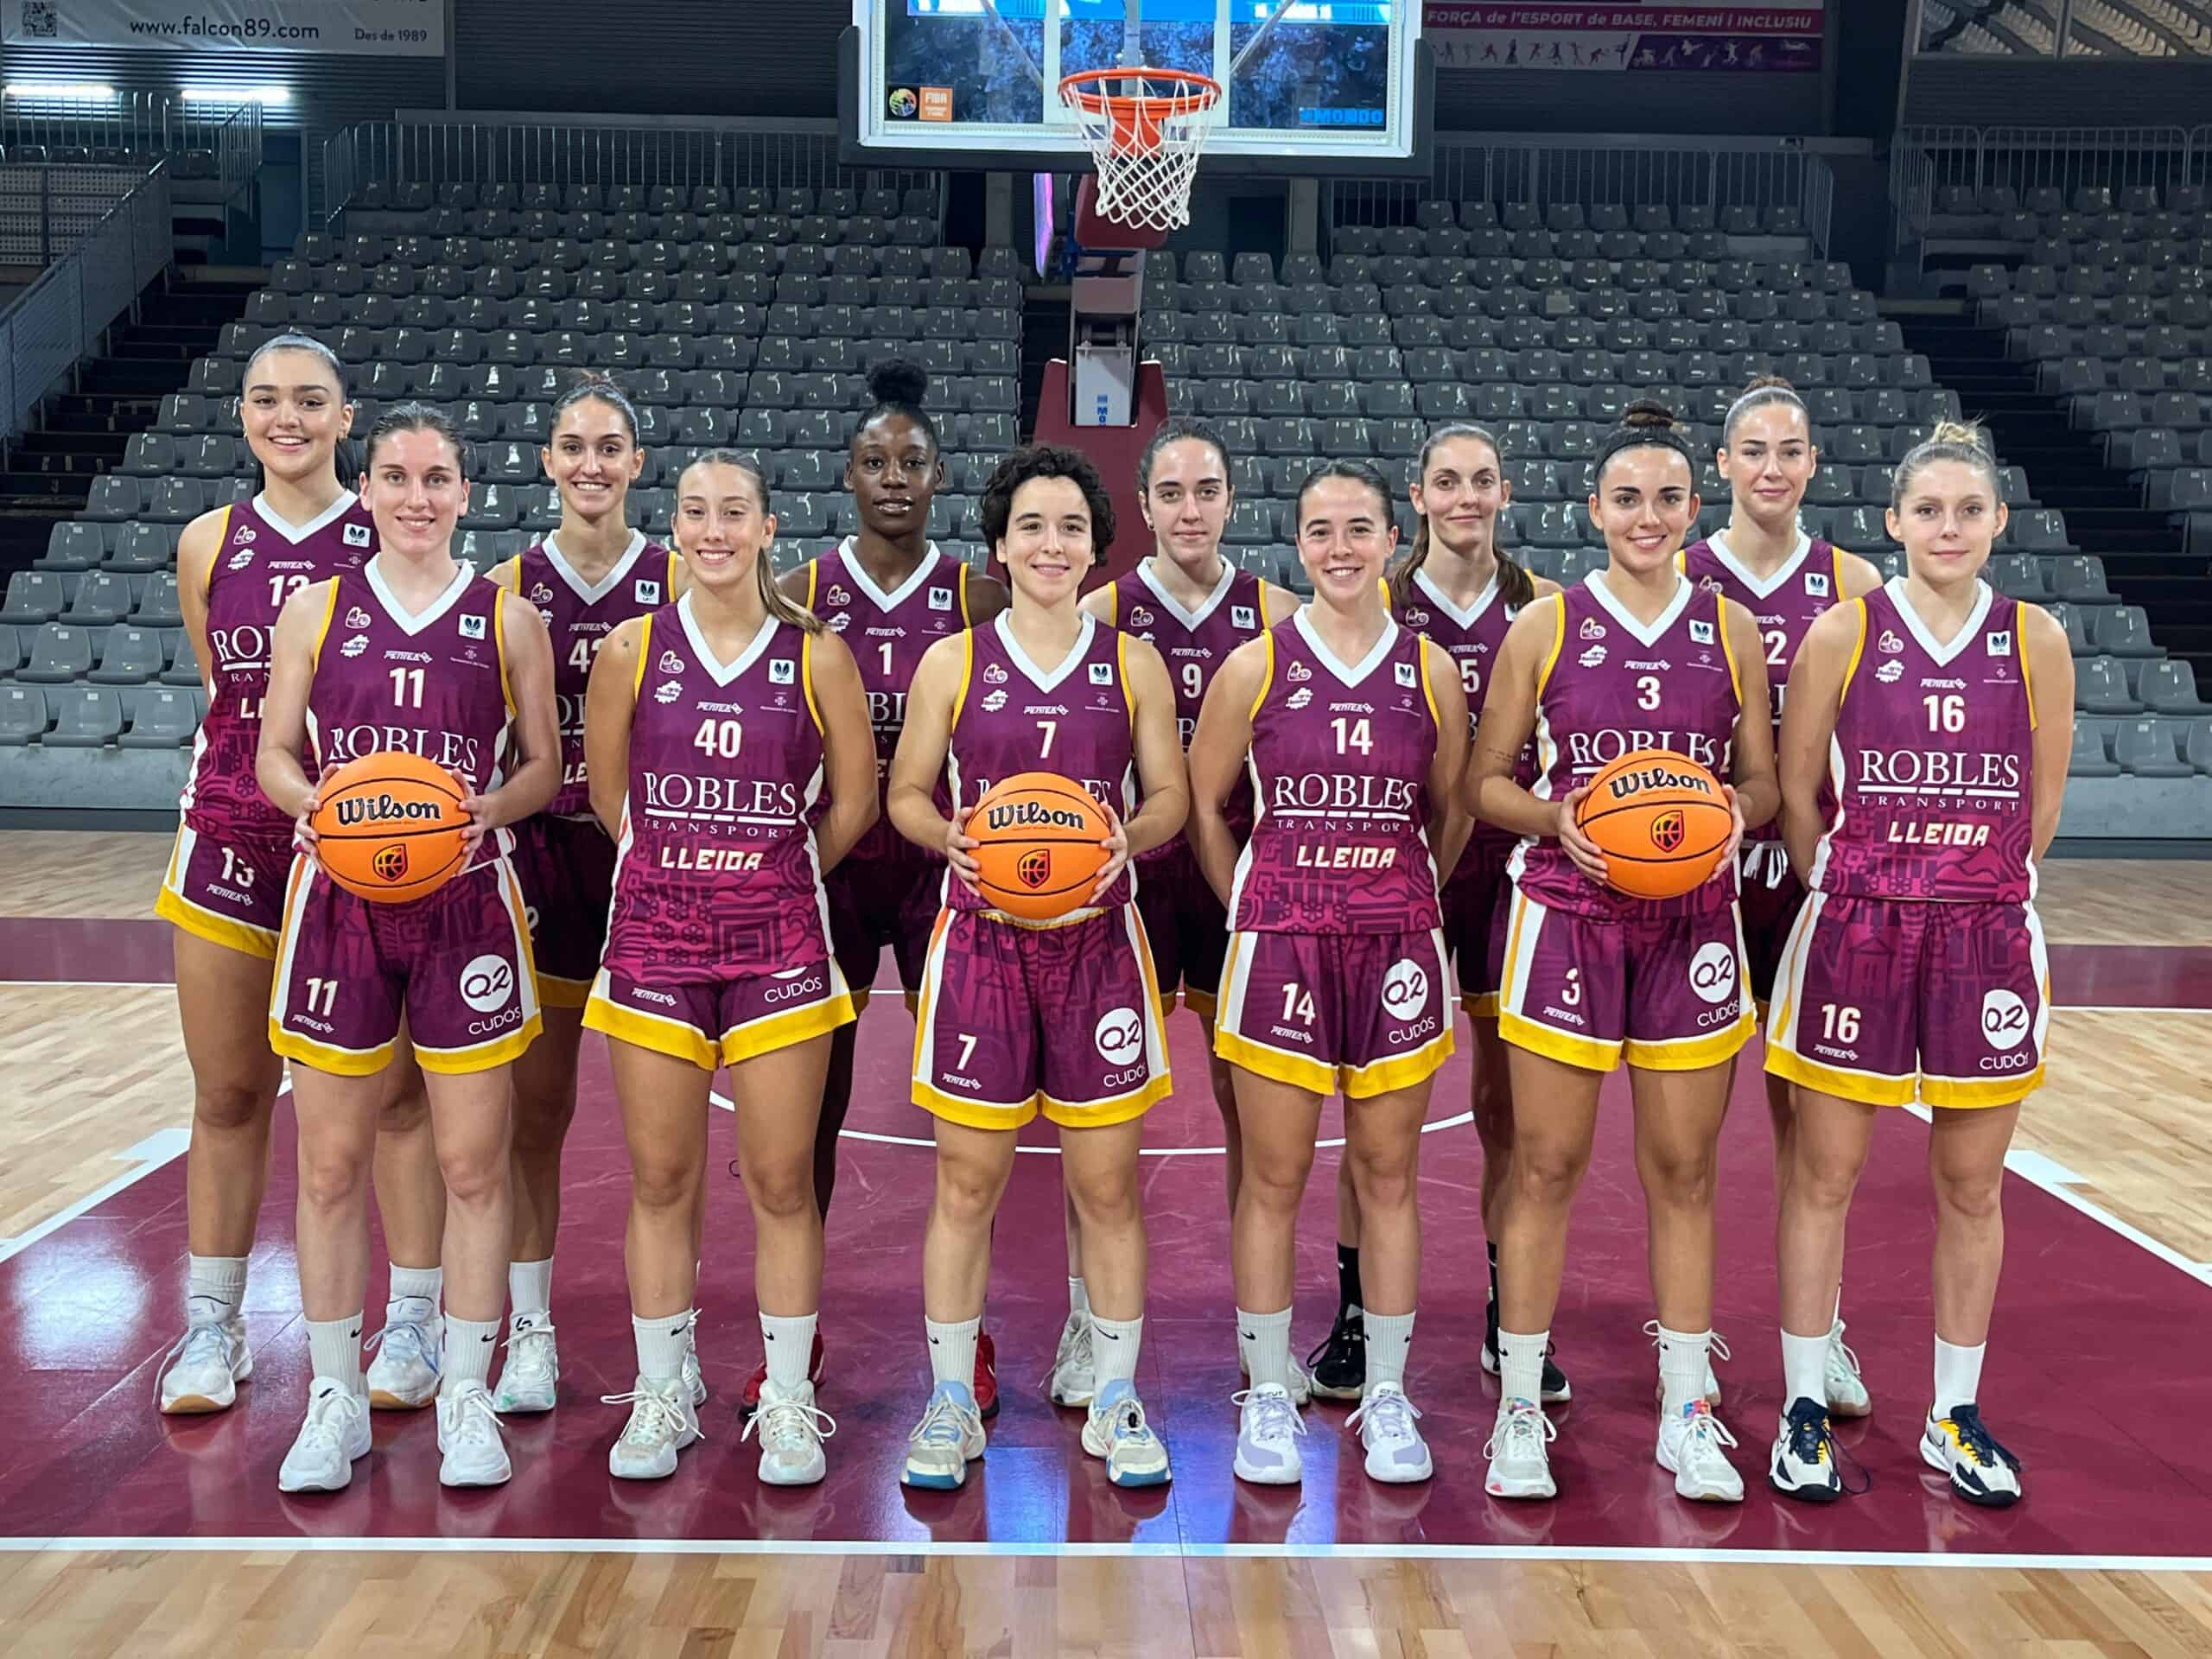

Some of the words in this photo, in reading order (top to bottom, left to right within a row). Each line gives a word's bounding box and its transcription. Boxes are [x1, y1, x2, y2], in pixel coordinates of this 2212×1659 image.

[130, 16, 319, 39] www.falcon89.com
[354, 27, 377, 41] Des
[380, 28, 394, 41] de
[398, 29, 428, 41] 1989
[1427, 11, 1481, 26] FORÇA
[1486, 11, 1507, 24] de
[1511, 11, 1583, 25] l'ESPORT
[1587, 13, 1605, 25] de
[1611, 14, 1657, 27] BASE,
[1736, 16, 1812, 29] INCLUSIU
[568, 638, 605, 674] 4
[878, 642, 892, 676] 1
[389, 667, 424, 708] 11
[1182, 664, 1202, 698] 9
[1460, 658, 1479, 693] 5
[1637, 676, 1661, 710] 3
[1923, 694, 1965, 733] 16
[694, 718, 742, 759] 40
[1036, 721, 1057, 759] 7
[1330, 717, 1373, 755] 14
[1608, 767, 1711, 799] Wilson
[1859, 749, 2019, 788] ROBLES
[643, 772, 797, 816] ROBLES
[1273, 773, 1418, 810] ROBLES
[1859, 795, 2019, 811] TRANSPORT
[335, 794, 442, 826] Wilson
[988, 801, 1085, 830] Wilson
[644, 818, 795, 838] TRANSPORT
[1888, 821, 1990, 846] LLEIDA
[661, 847, 763, 871] LLEIDA
[1296, 846, 1396, 868] LLEIDA
[463, 964, 512, 999] Q2
[1384, 971, 1424, 1006] Q2
[1561, 967, 1581, 1005] 3
[1694, 955, 1732, 988] Q2
[306, 977, 338, 1017] 11
[763, 976, 823, 1004] CUDÓS
[1282, 982, 1316, 1026] 14
[1099, 1018, 1140, 1051] Q2
[1821, 1003, 1861, 1044] 16
[1985, 1004, 2027, 1033] Q2
[957, 1033, 977, 1071] 7
